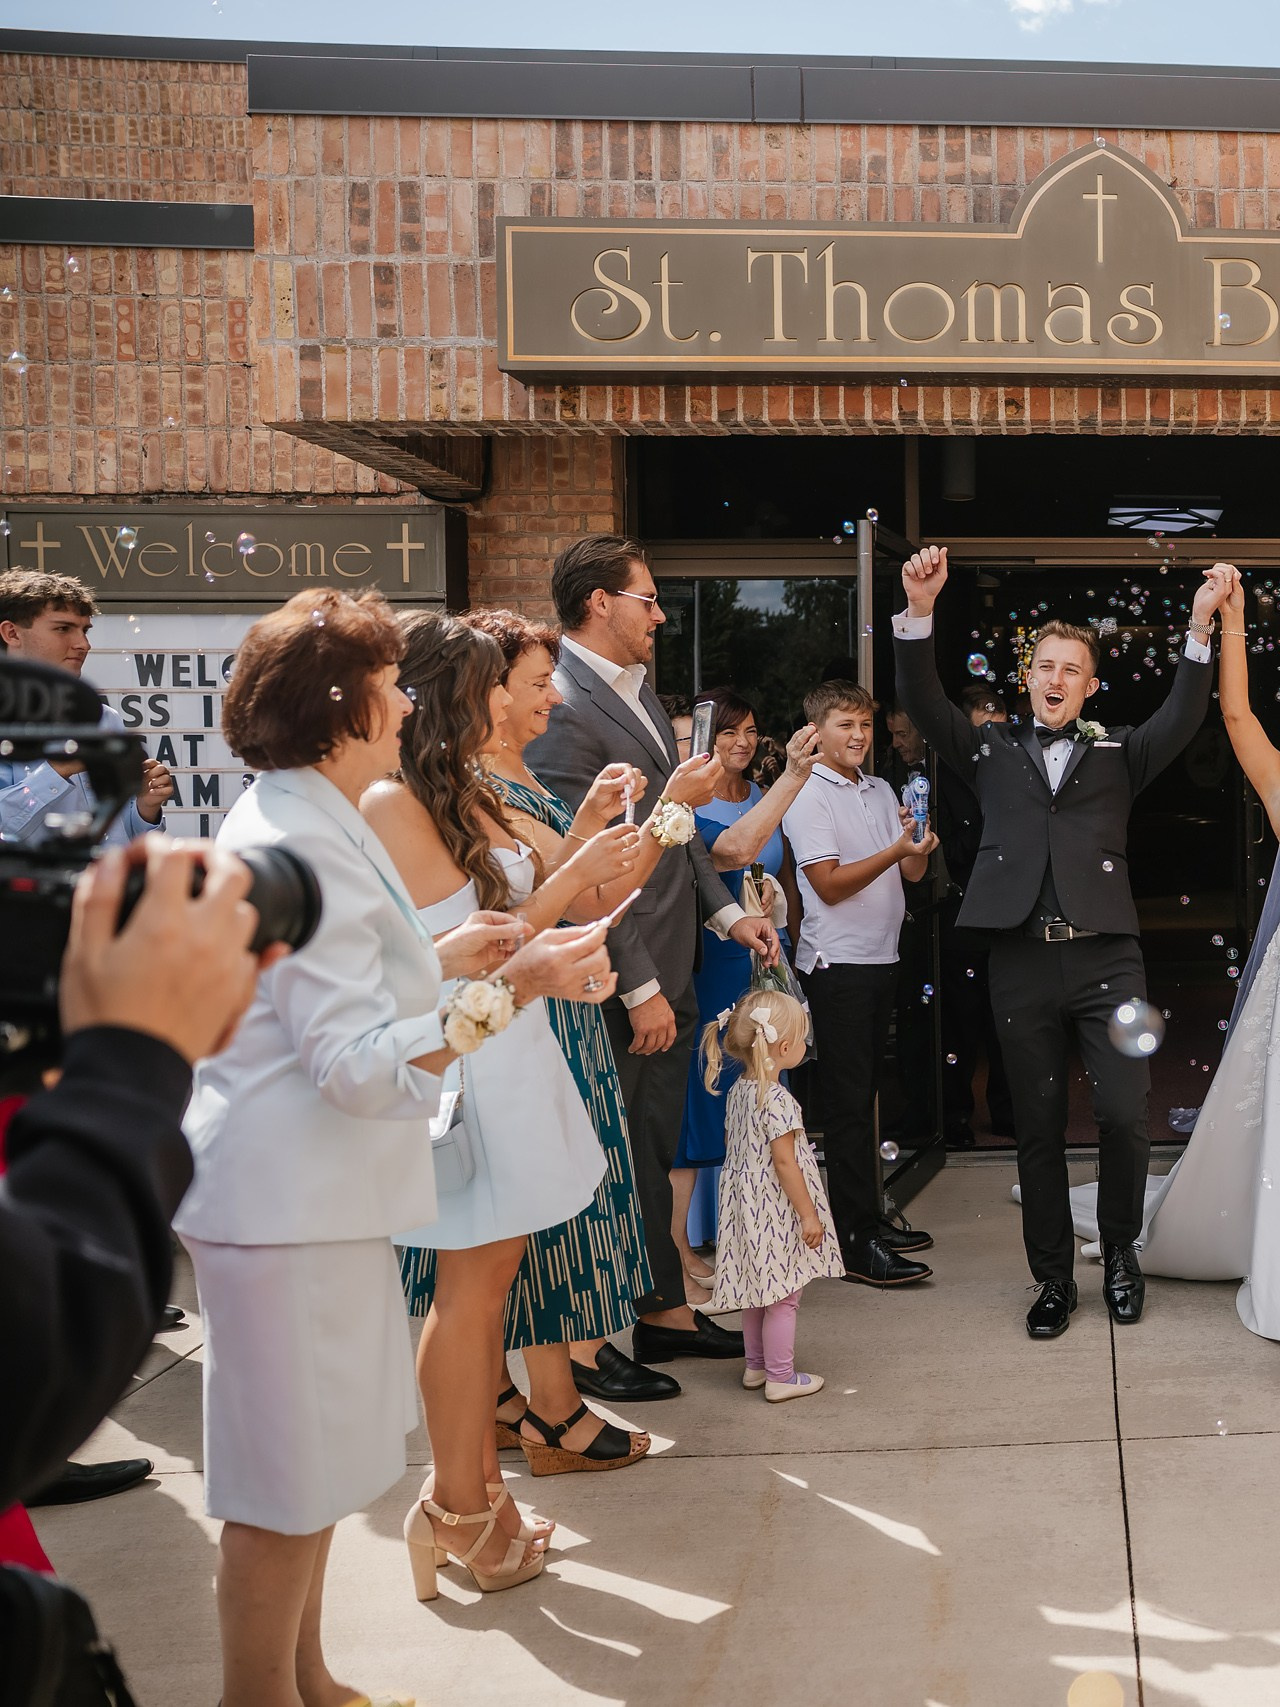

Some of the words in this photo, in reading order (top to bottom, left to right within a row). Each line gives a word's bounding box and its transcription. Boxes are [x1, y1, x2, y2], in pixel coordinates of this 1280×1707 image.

[570, 245, 722, 344] St.
[747, 241, 1163, 348] Thomas
[75, 521, 373, 578] Welcome
[100, 694, 170, 728] SS
[138, 734, 204, 767] AT
